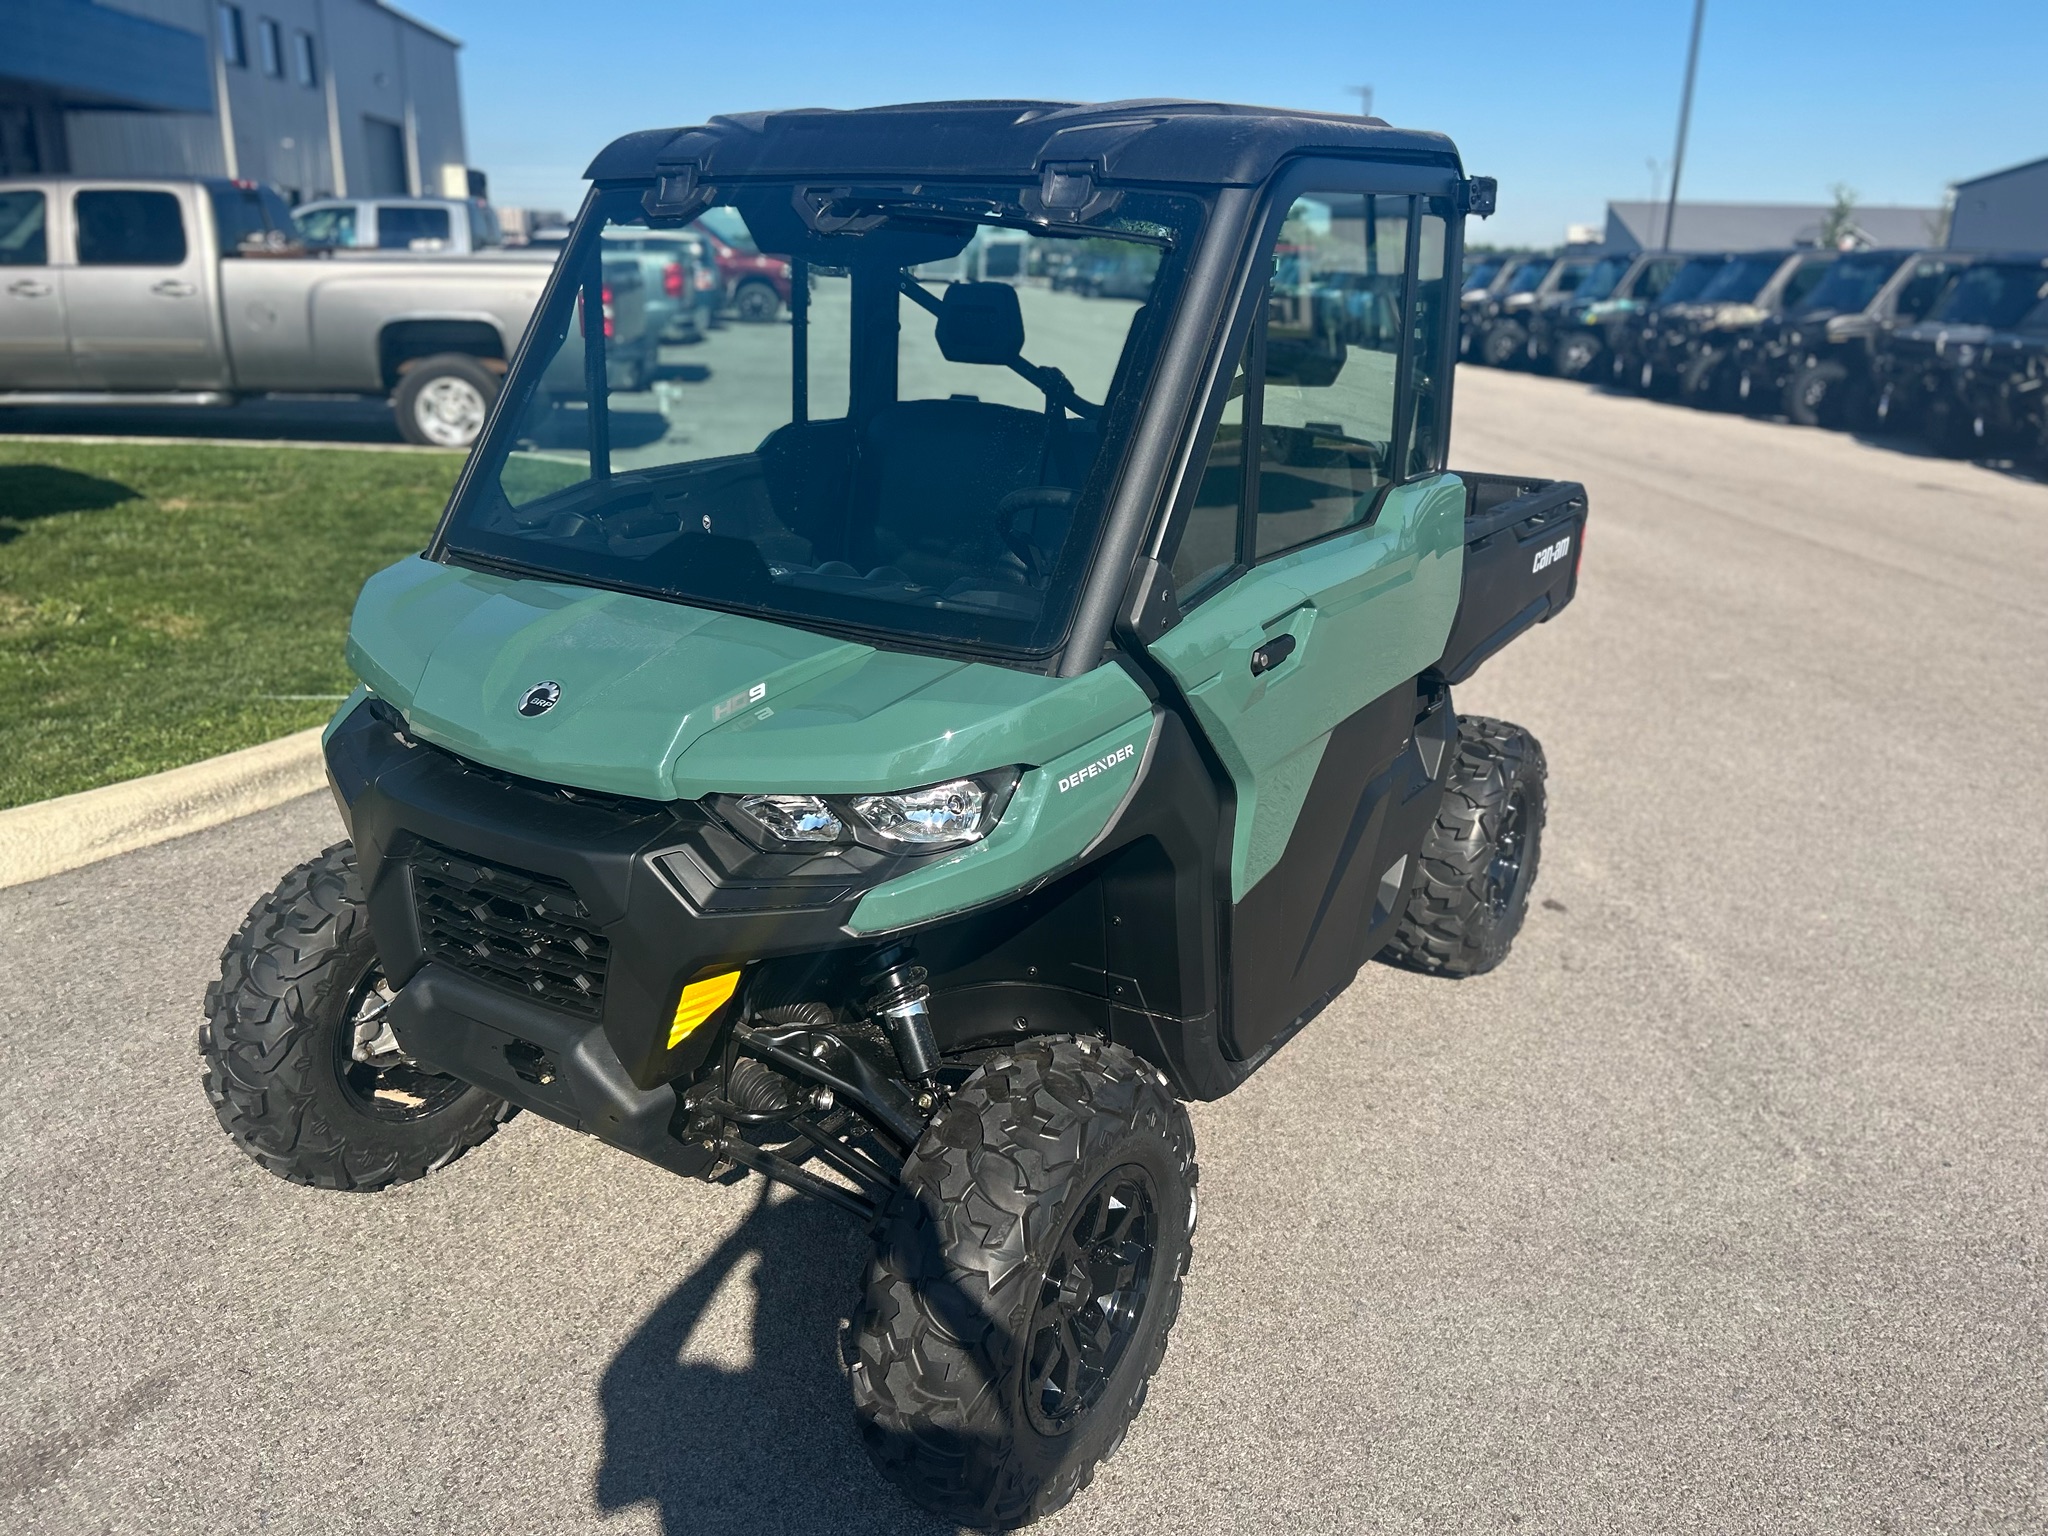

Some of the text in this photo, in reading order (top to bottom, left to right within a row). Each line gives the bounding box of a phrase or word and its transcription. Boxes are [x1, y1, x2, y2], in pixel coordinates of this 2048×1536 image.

[1532, 535, 1571, 574] can-am
[529, 697, 553, 708] BRP
[714, 682, 766, 721] HD9
[1057, 743, 1135, 793] DEFENDER
